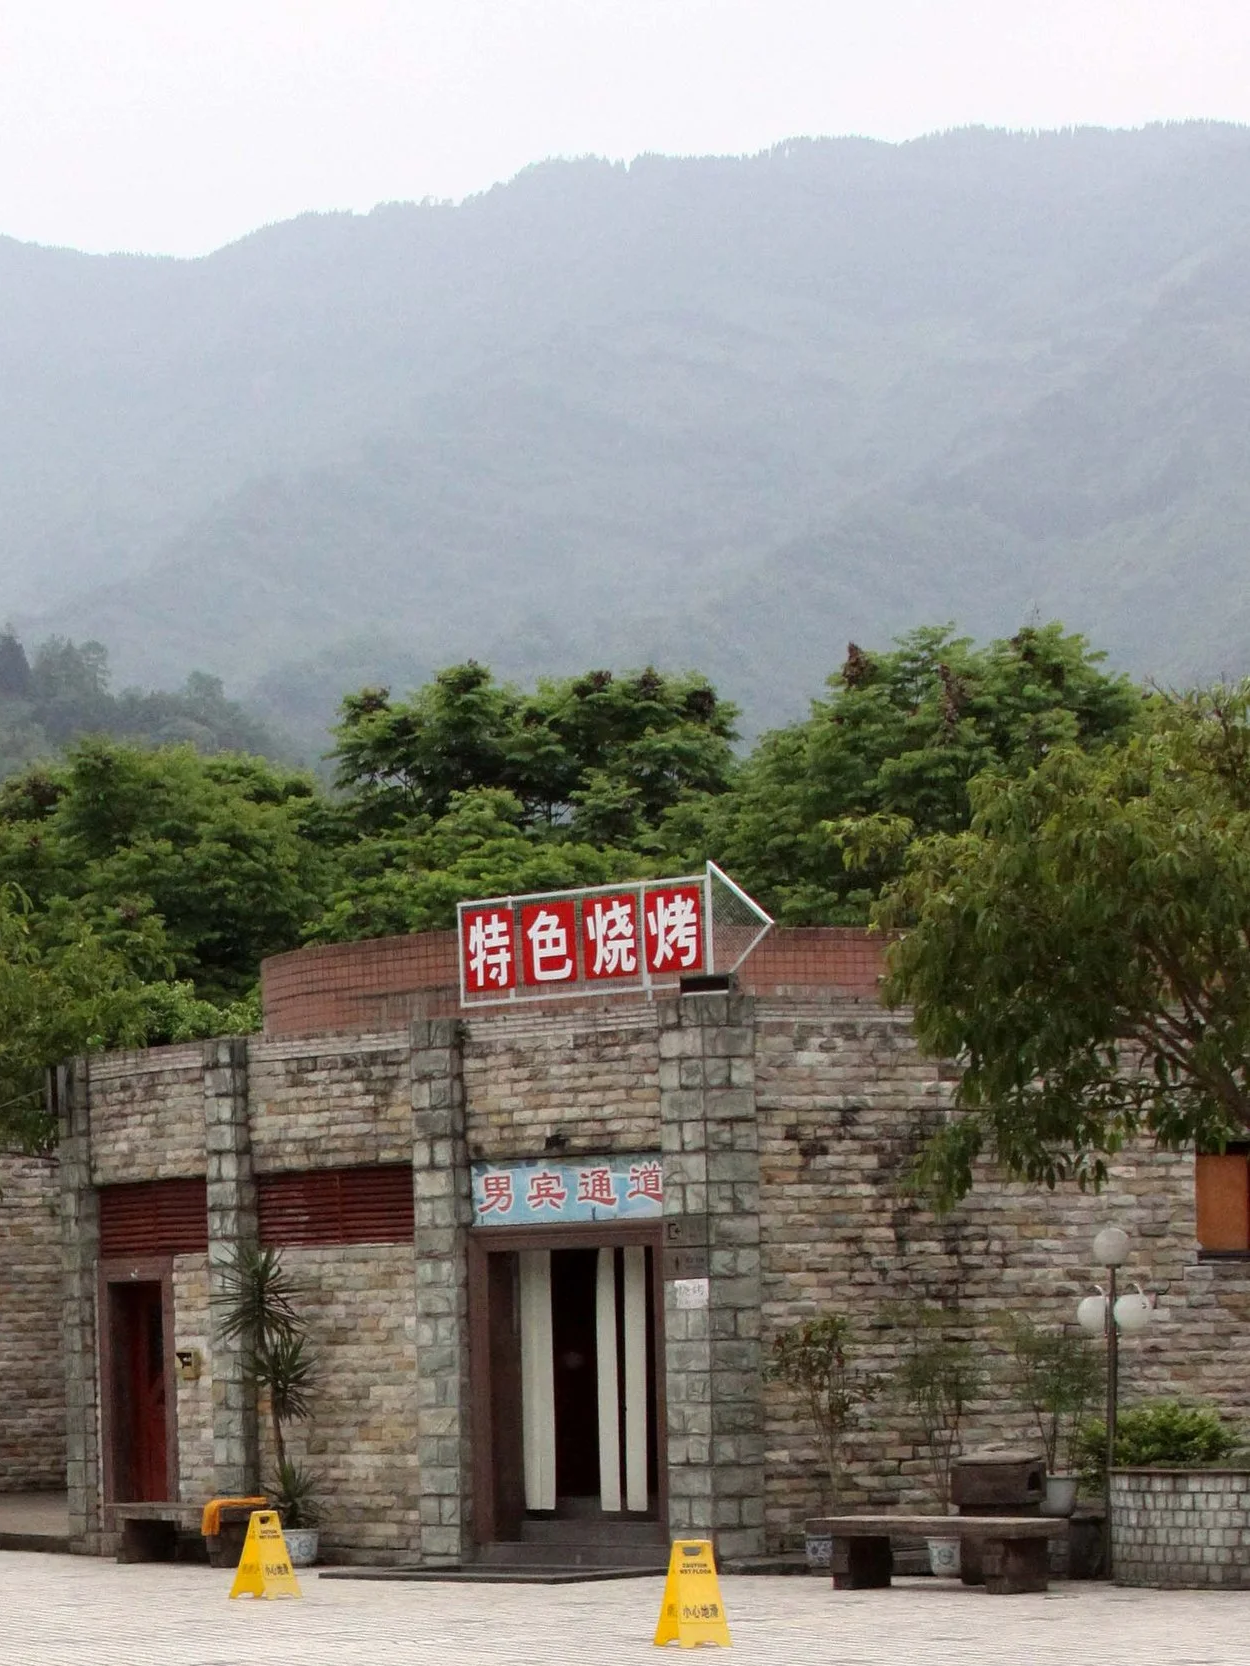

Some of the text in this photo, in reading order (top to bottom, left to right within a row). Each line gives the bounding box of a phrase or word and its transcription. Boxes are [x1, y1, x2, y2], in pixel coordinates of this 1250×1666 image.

[469, 894, 698, 987] 特色烧烤
[477, 1159, 663, 1215] 男宾通道
[682, 1603, 719, 1619] 小心地滑
